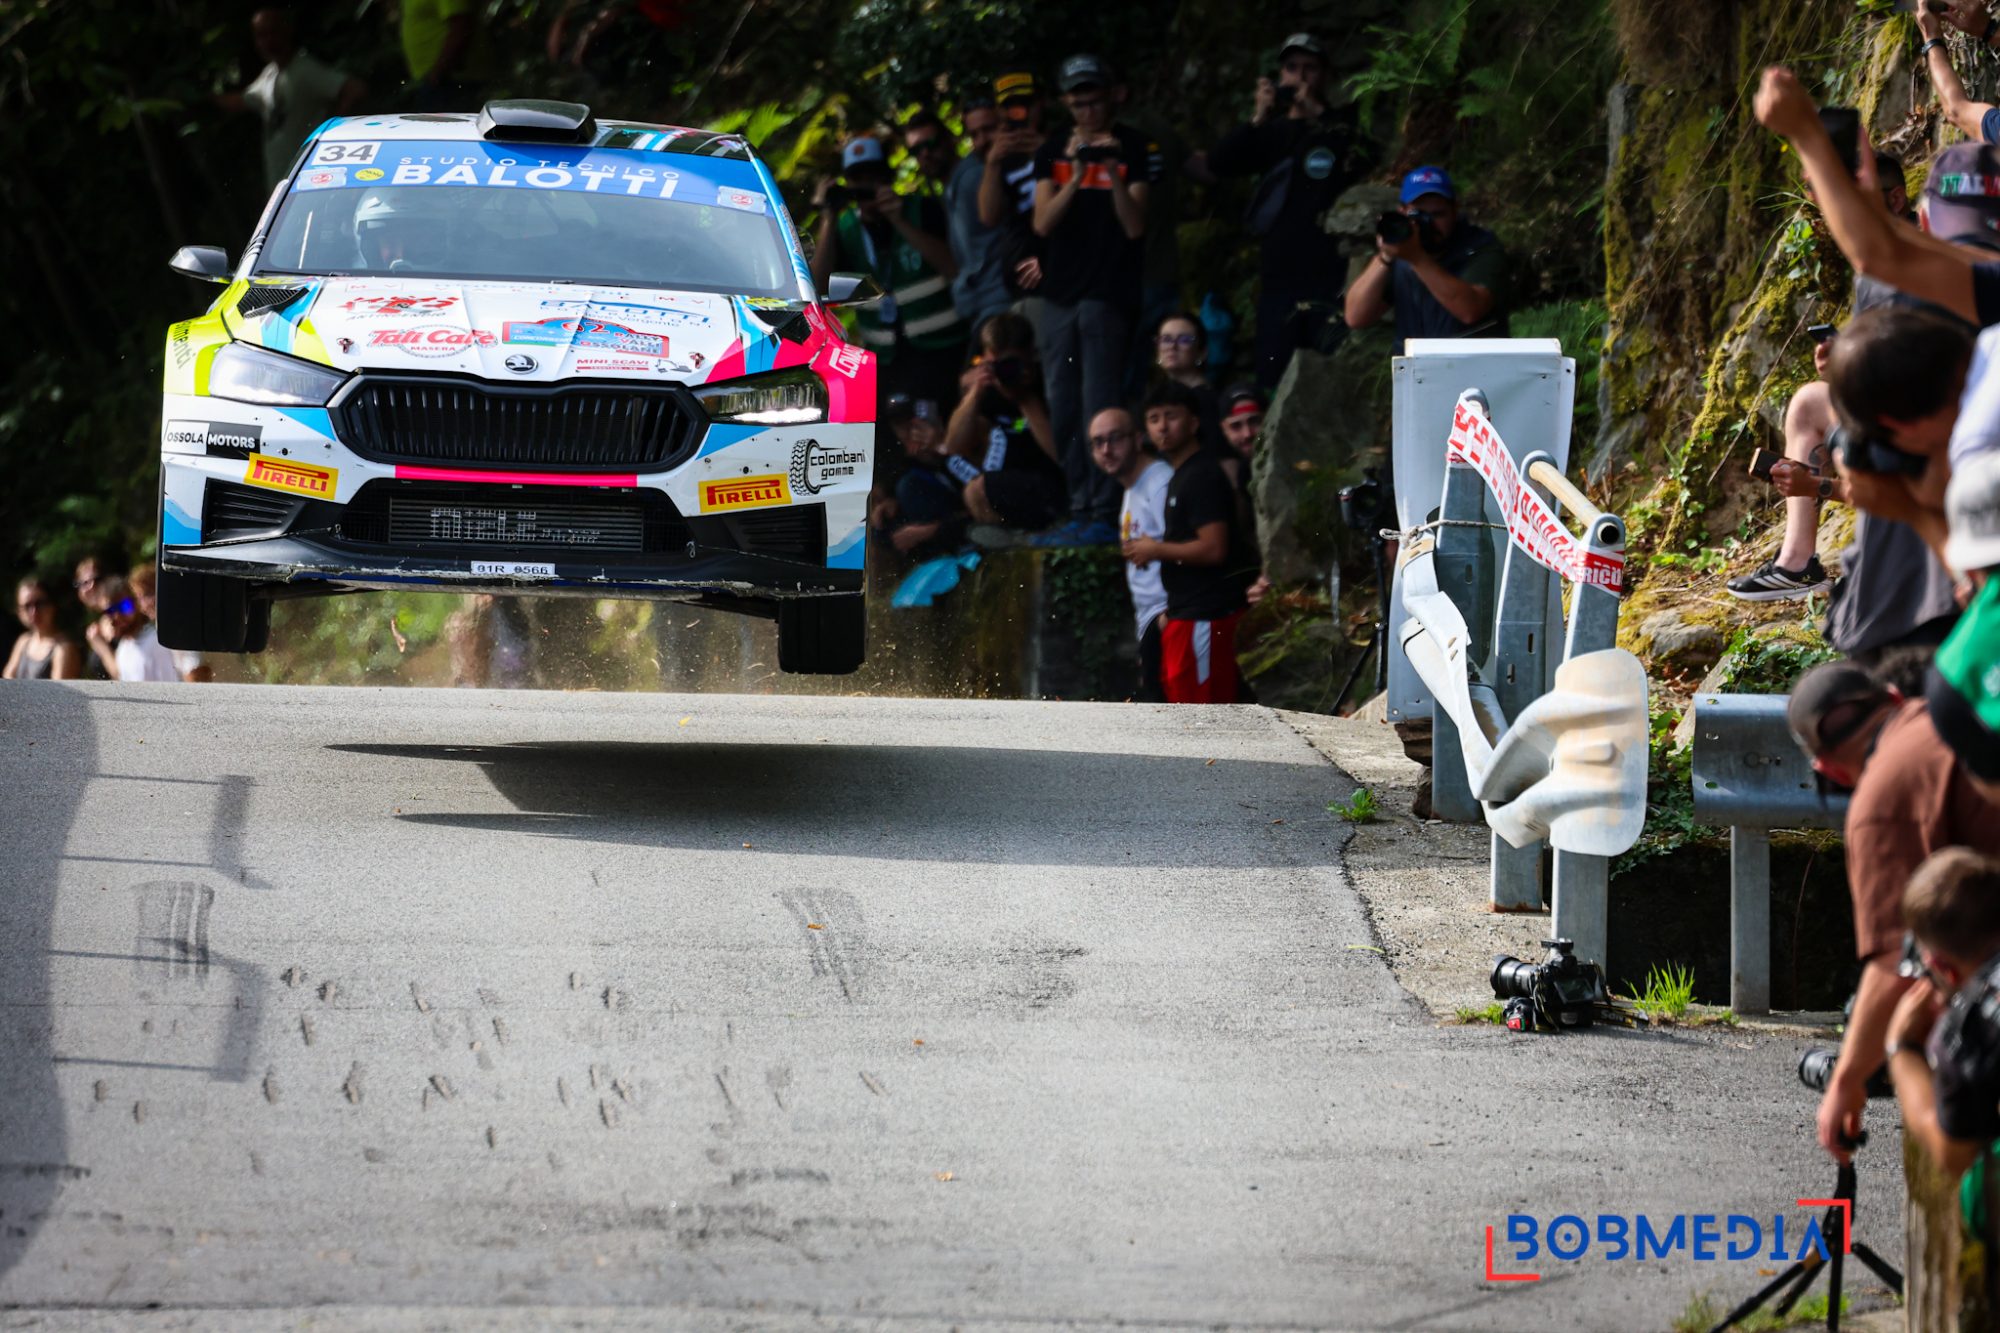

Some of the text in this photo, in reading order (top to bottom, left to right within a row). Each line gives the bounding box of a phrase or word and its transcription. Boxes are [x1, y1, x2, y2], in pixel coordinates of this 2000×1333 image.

[319, 145, 373, 161] 34
[400, 156, 680, 180] STUDIO TECNICO
[391, 164, 680, 198] BALOTTI
[167, 431, 256, 449] OSSOLA MOTORS
[810, 449, 866, 466] colombani
[252, 460, 330, 492] PIRELLI
[821, 466, 854, 480] gomme
[706, 479, 782, 506] PIRELLI
